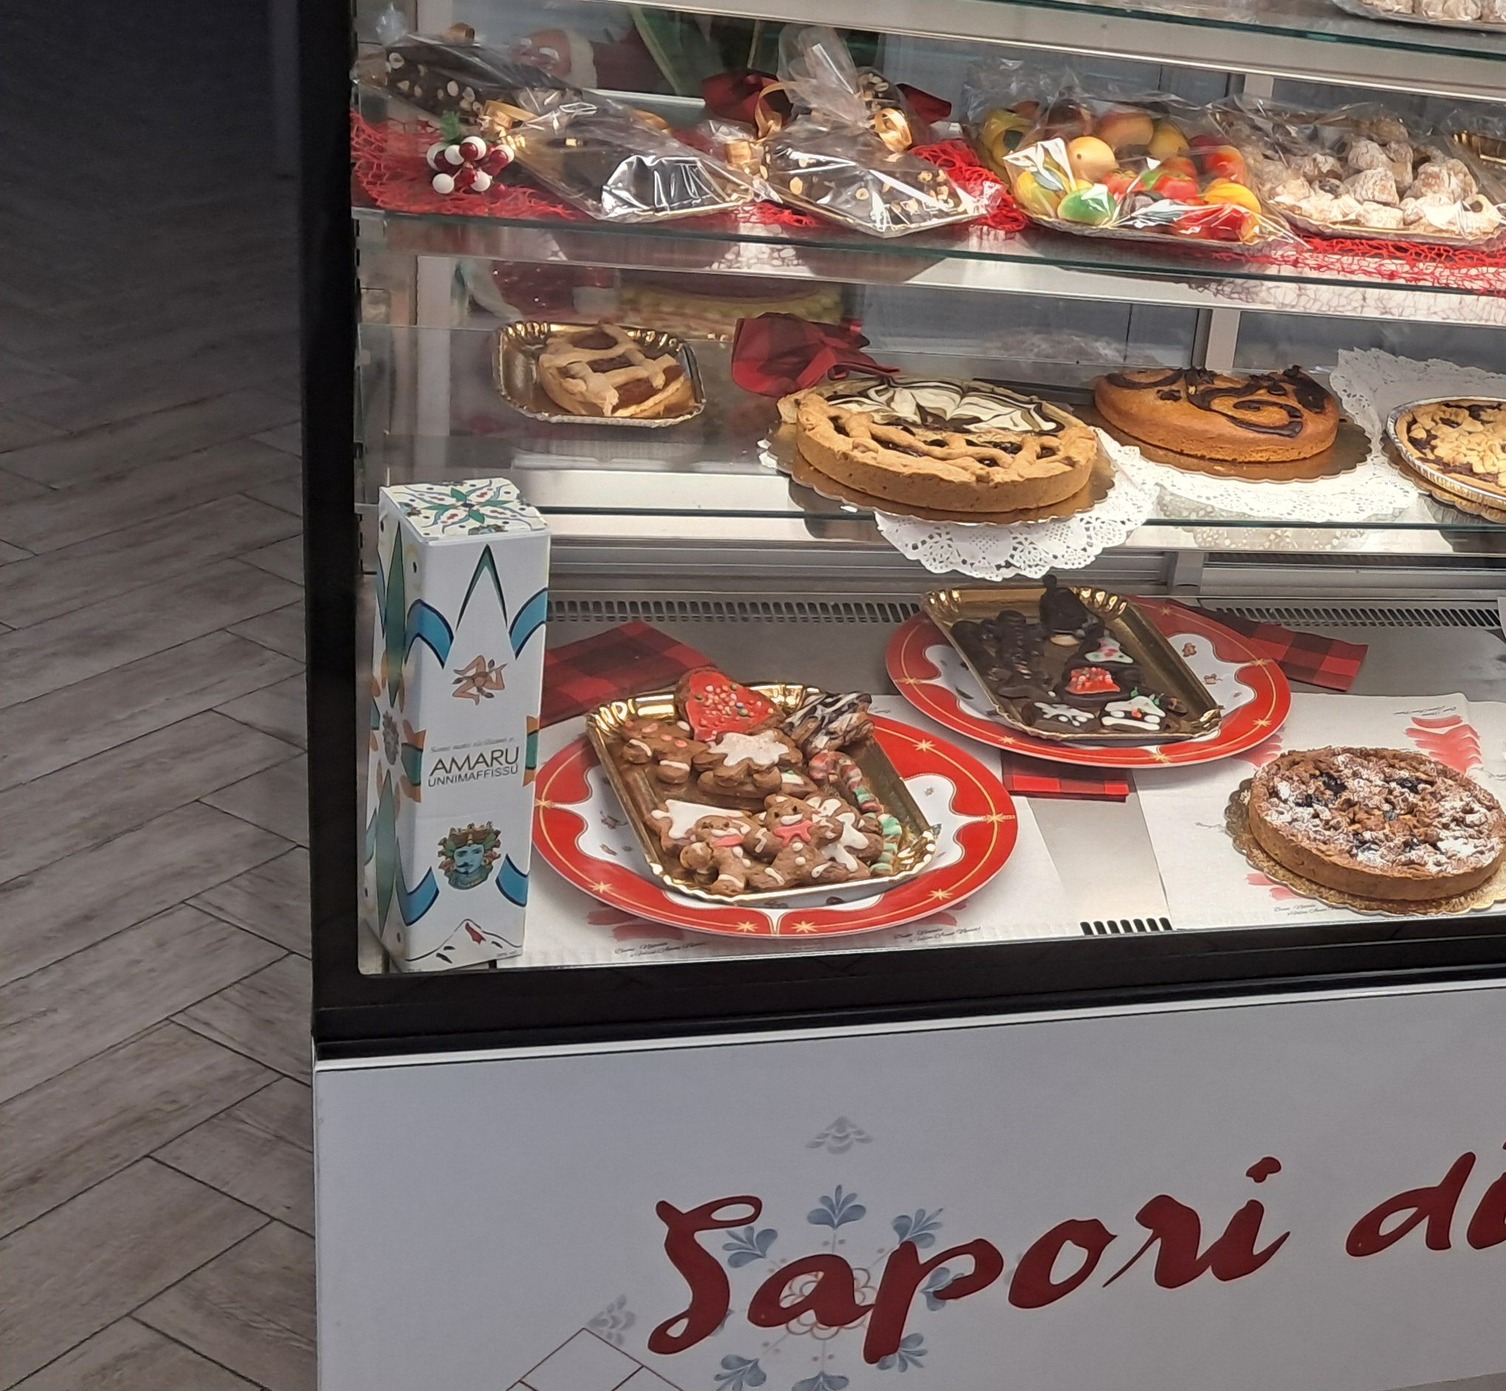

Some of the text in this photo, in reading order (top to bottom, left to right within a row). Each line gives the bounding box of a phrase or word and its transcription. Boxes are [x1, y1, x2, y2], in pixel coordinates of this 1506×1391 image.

[427, 764, 519, 788] UNNIMAFFISSU
[429, 746, 519, 777] AMARU
[647, 1157, 1290, 1364] Sapori
